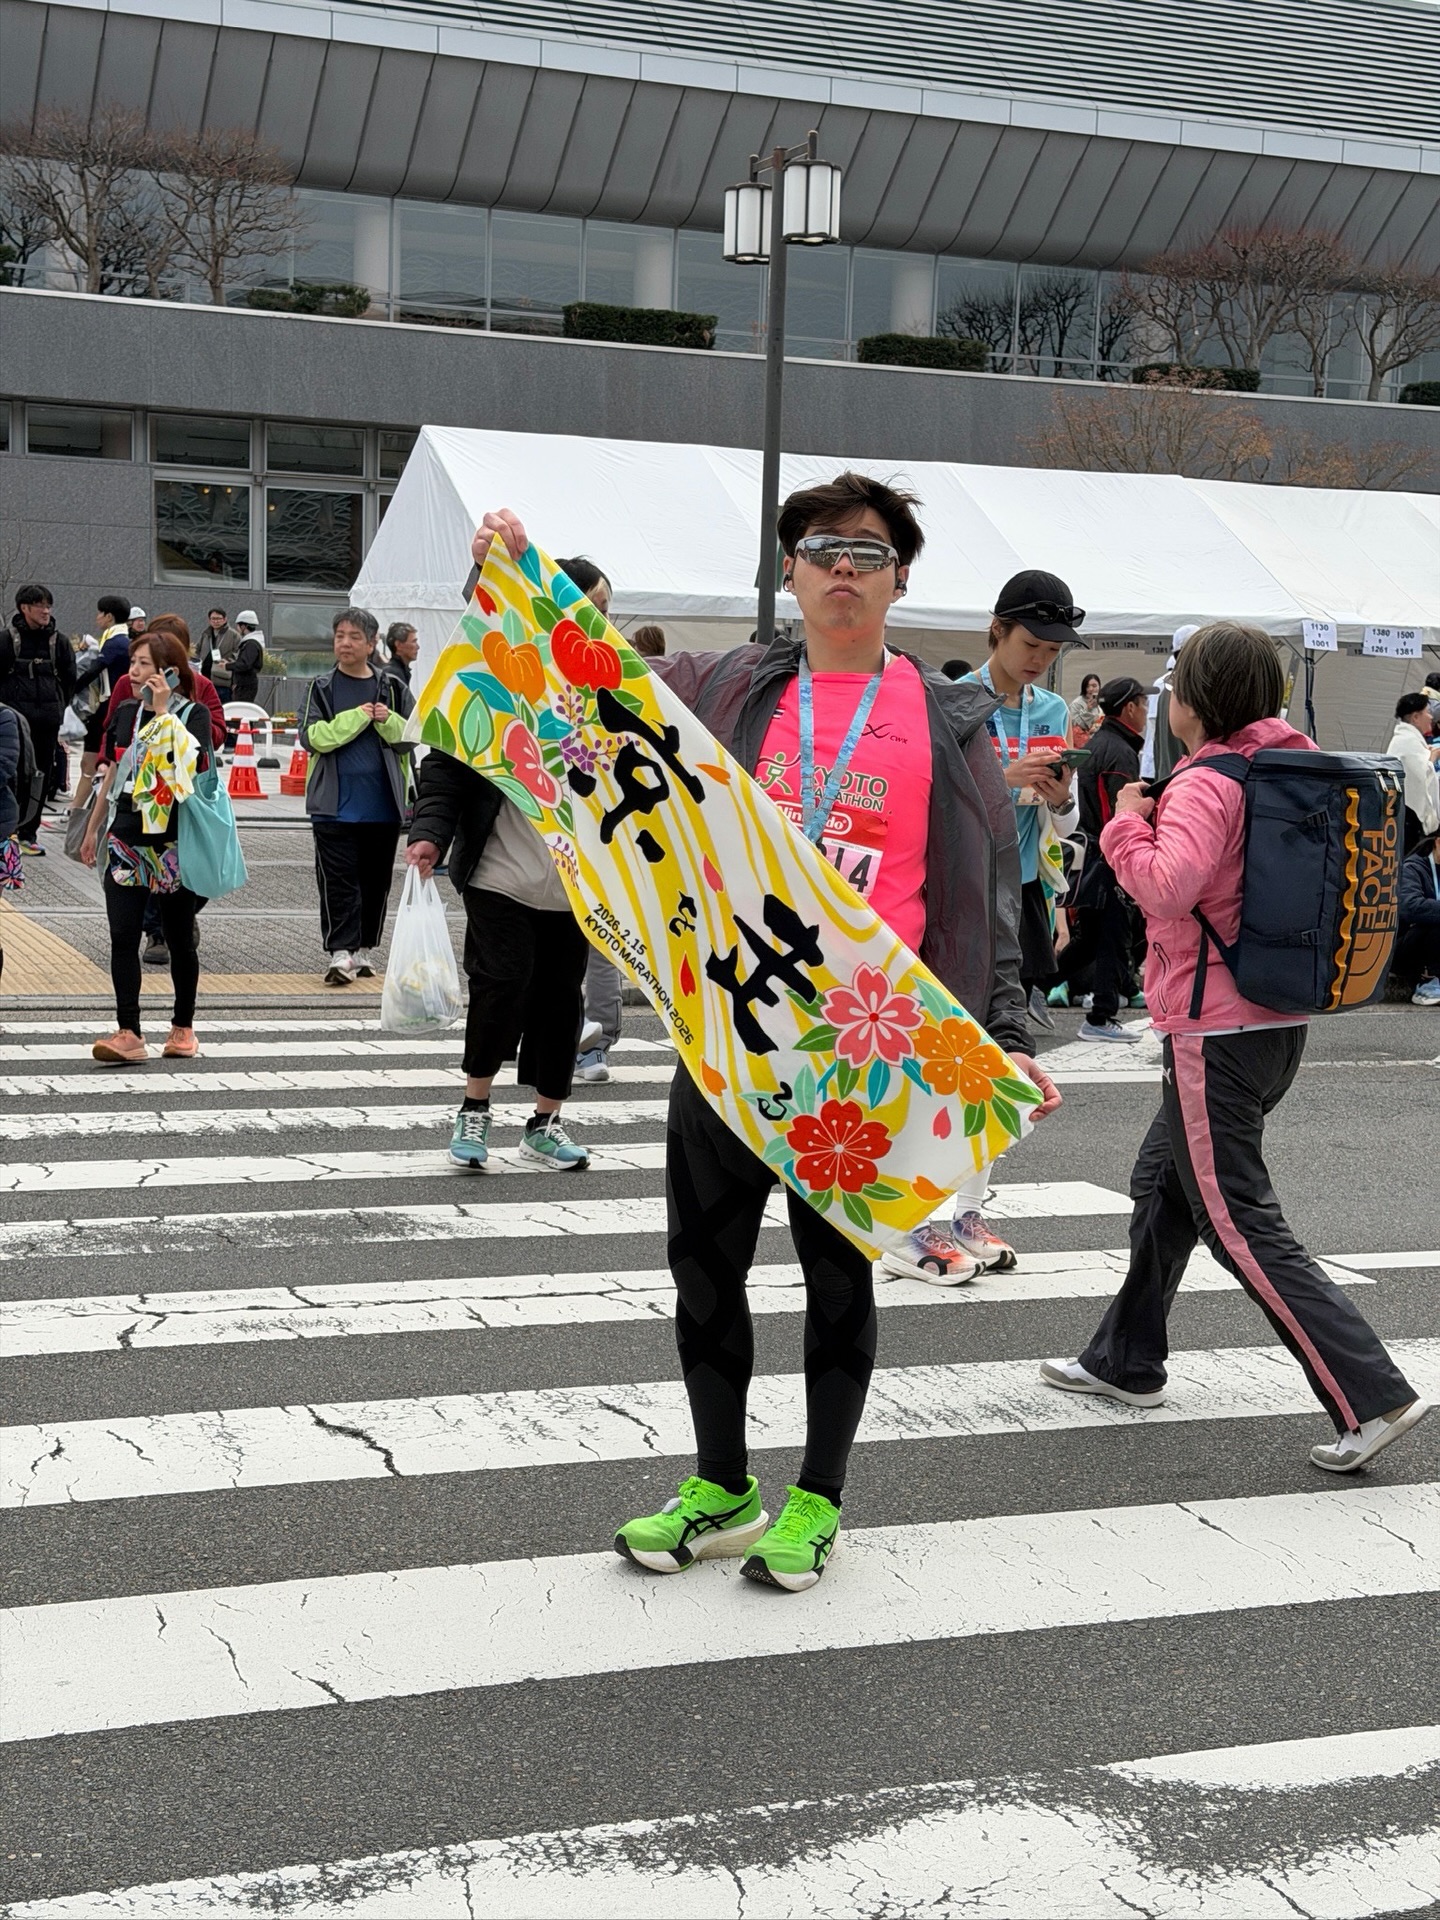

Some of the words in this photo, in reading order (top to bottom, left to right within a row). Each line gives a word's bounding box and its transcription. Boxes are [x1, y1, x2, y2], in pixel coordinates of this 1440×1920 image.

[1311, 623, 1329, 631] 1130
[1372, 628, 1390, 637] 1380
[1396, 631, 1415, 639] 1500
[1102, 641, 1118, 649] 1131
[1124, 641, 1139, 649] 1261
[1312, 640, 1329, 648] 1001
[801, 787, 884, 812] AATHON
[1374, 789, 1398, 929] NORTH
[1358, 828, 1384, 930] FACE
[593, 903, 648, 956] 2026.2.15
[584, 914, 621, 952] KYOTO
[618, 947, 673, 1011] MARATHON
[669, 1007, 694, 1045] 2026
